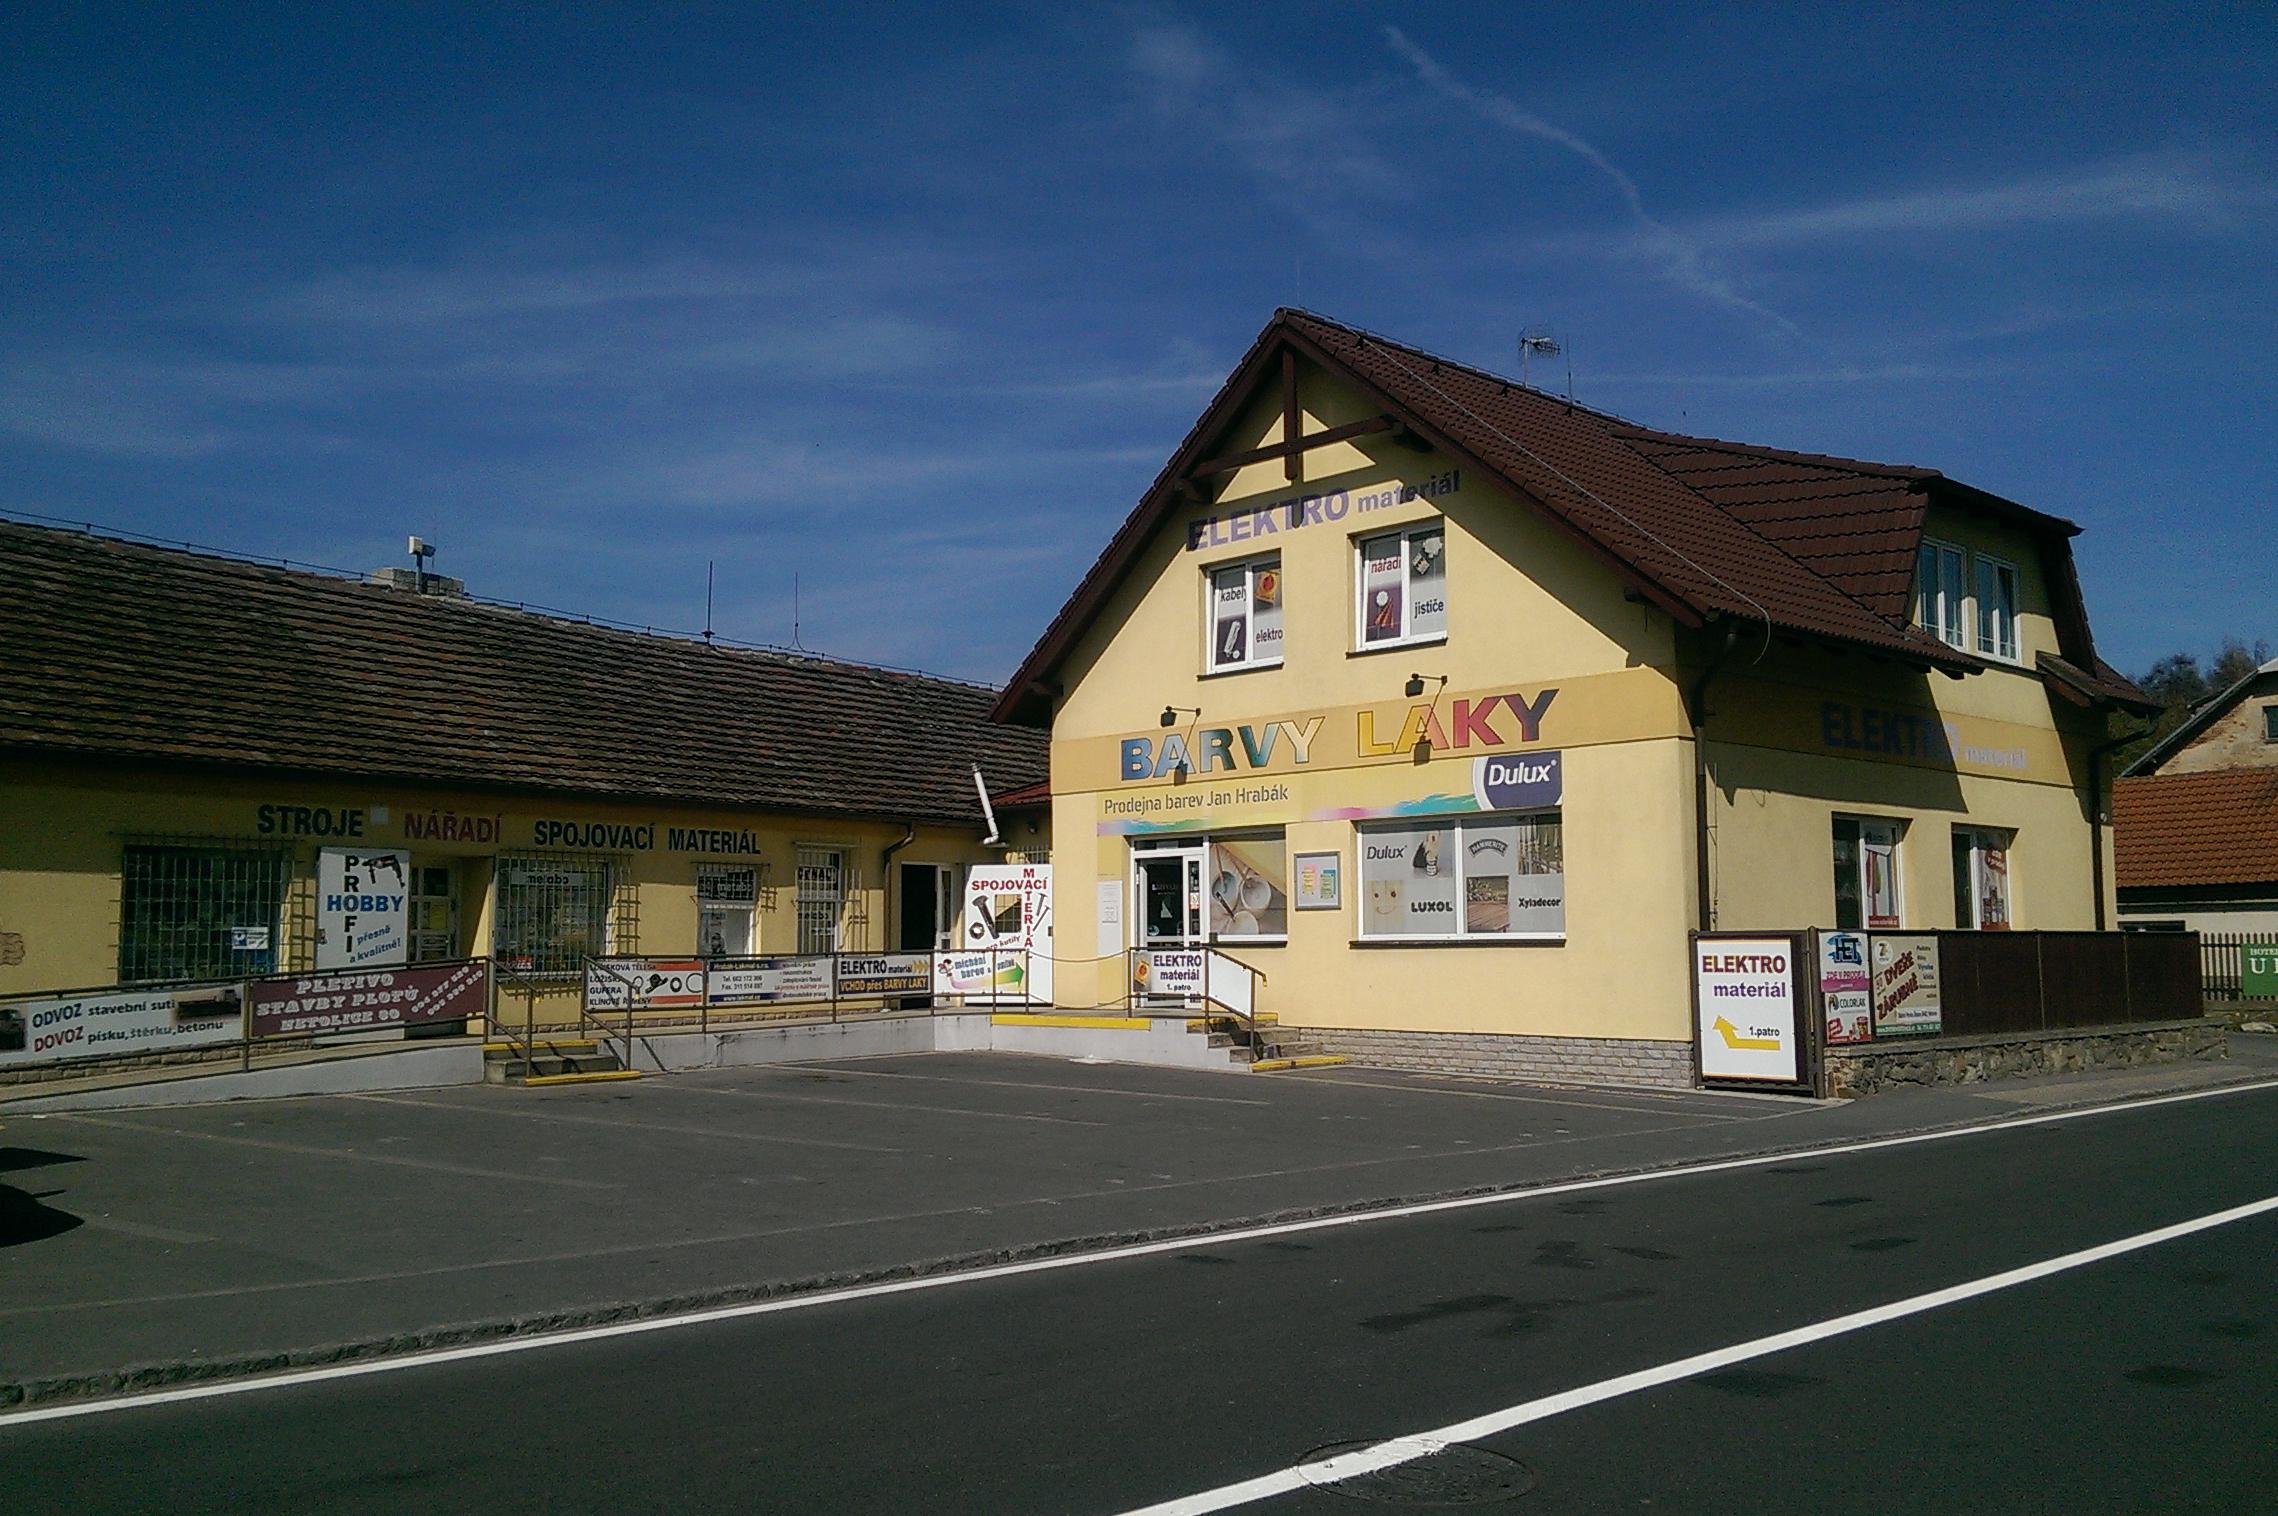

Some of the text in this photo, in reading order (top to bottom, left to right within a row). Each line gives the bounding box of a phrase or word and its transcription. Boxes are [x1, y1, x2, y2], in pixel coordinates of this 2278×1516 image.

[1186, 470, 1461, 552] ELEKTRO materiál
[1220, 585, 1247, 603] kabely
[1414, 599, 1444, 619] jističe
[1256, 628, 1284, 644] elektro
[1121, 688, 1560, 782] BARVY LAKY
[1488, 762, 1552, 787] Dulux
[1104, 785, 1289, 815] Prodejna barev Jan Hrabák
[258, 804, 761, 855] STROJE NÁŘADÍ SPOJOVACÍ MATERIÁL
[1367, 845, 1404, 860] Dulux
[971, 876, 1048, 891] SPOJOVACÍ
[326, 894, 404, 912] HOBBY
[1023, 868, 1035, 952] MATERIÁ
[1411, 901, 1453, 913] LUXOL
[1518, 897, 1562, 909] Xyladecor
[357, 925, 391, 945] přesně
[840, 960, 887, 975] ELEKTRO
[1153, 954, 1202, 968] ELEKTRO
[1702, 955, 1786, 974] ELEKTRO
[1160, 967, 1200, 981] materiál
[296, 973, 394, 995] PLETIVO
[840, 980, 865, 992] VCHOD
[1713, 981, 1786, 998] materiál
[256, 984, 420, 1017] STAVBY PLOTŮ
[32, 1003, 82, 1028] ODVOZ
[88, 1001, 147, 1017] stavební
[280, 1010, 374, 1031] NETOLICE
[34, 1026, 84, 1052] DOVOZ
